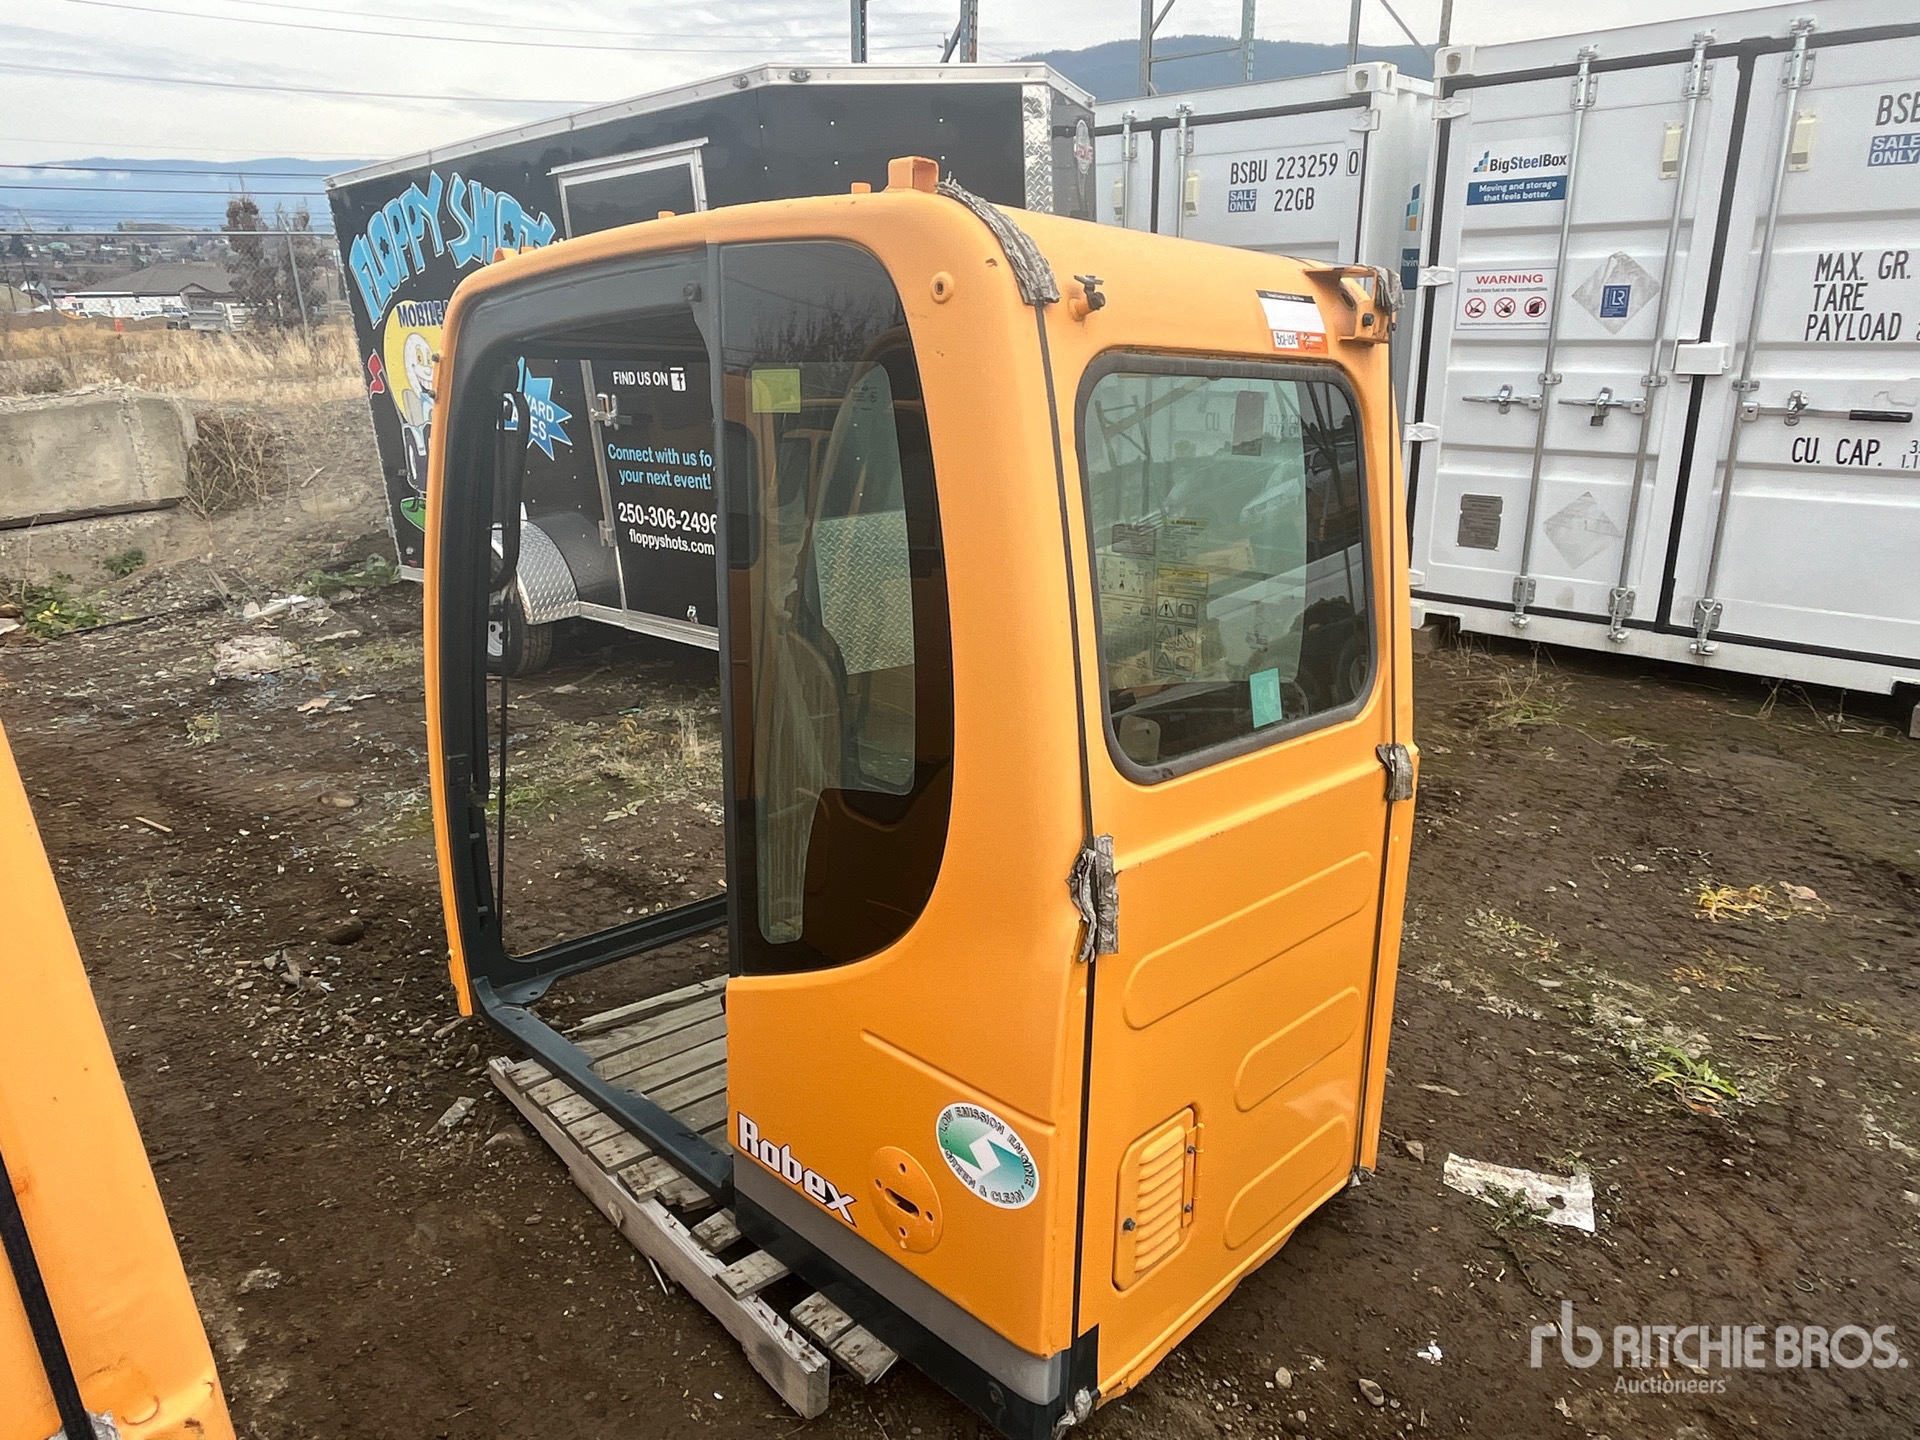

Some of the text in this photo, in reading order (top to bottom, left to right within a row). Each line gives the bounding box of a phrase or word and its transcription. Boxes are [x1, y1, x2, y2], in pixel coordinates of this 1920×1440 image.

[1873, 135, 1920, 150] SALE
[1230, 160, 1267, 185] BSBU
[1276, 153, 1338, 180] 223259
[1490, 154, 1567, 173] BigSteelBox
[1871, 149, 1919, 165] ONLY
[1230, 190, 1257, 200] SALE
[1274, 187, 1315, 212] 22GB
[1479, 181, 1558, 193] Moving and storage
[1483, 191, 1551, 202] that feels better.
[1229, 201, 1256, 212] ONLY
[349, 169, 445, 330] FLOPPY
[1814, 250, 1911, 281] MAX. GR.
[1476, 274, 1543, 284] WARNING
[1813, 283, 1868, 311] TARE
[396, 300, 443, 328] MOBILE
[1804, 313, 1902, 341] PAYLOAD
[613, 371, 636, 385] FIND
[637, 371, 651, 386] US
[652, 371, 669, 386] ON
[608, 443, 654, 463] Connect
[655, 447, 680, 465] with
[682, 452, 697, 466] us
[1792, 437, 1821, 464] CU.
[1836, 438, 1882, 466] CAP.
[619, 469, 712, 490] your next event!
[629, 528, 716, 556] floppyshots.com
[940, 1106, 1035, 1188] LOW EMISSION ENGINE
[737, 1111, 857, 1228] Robex
[945, 1147, 1026, 1204] GREEN & CLEAN
